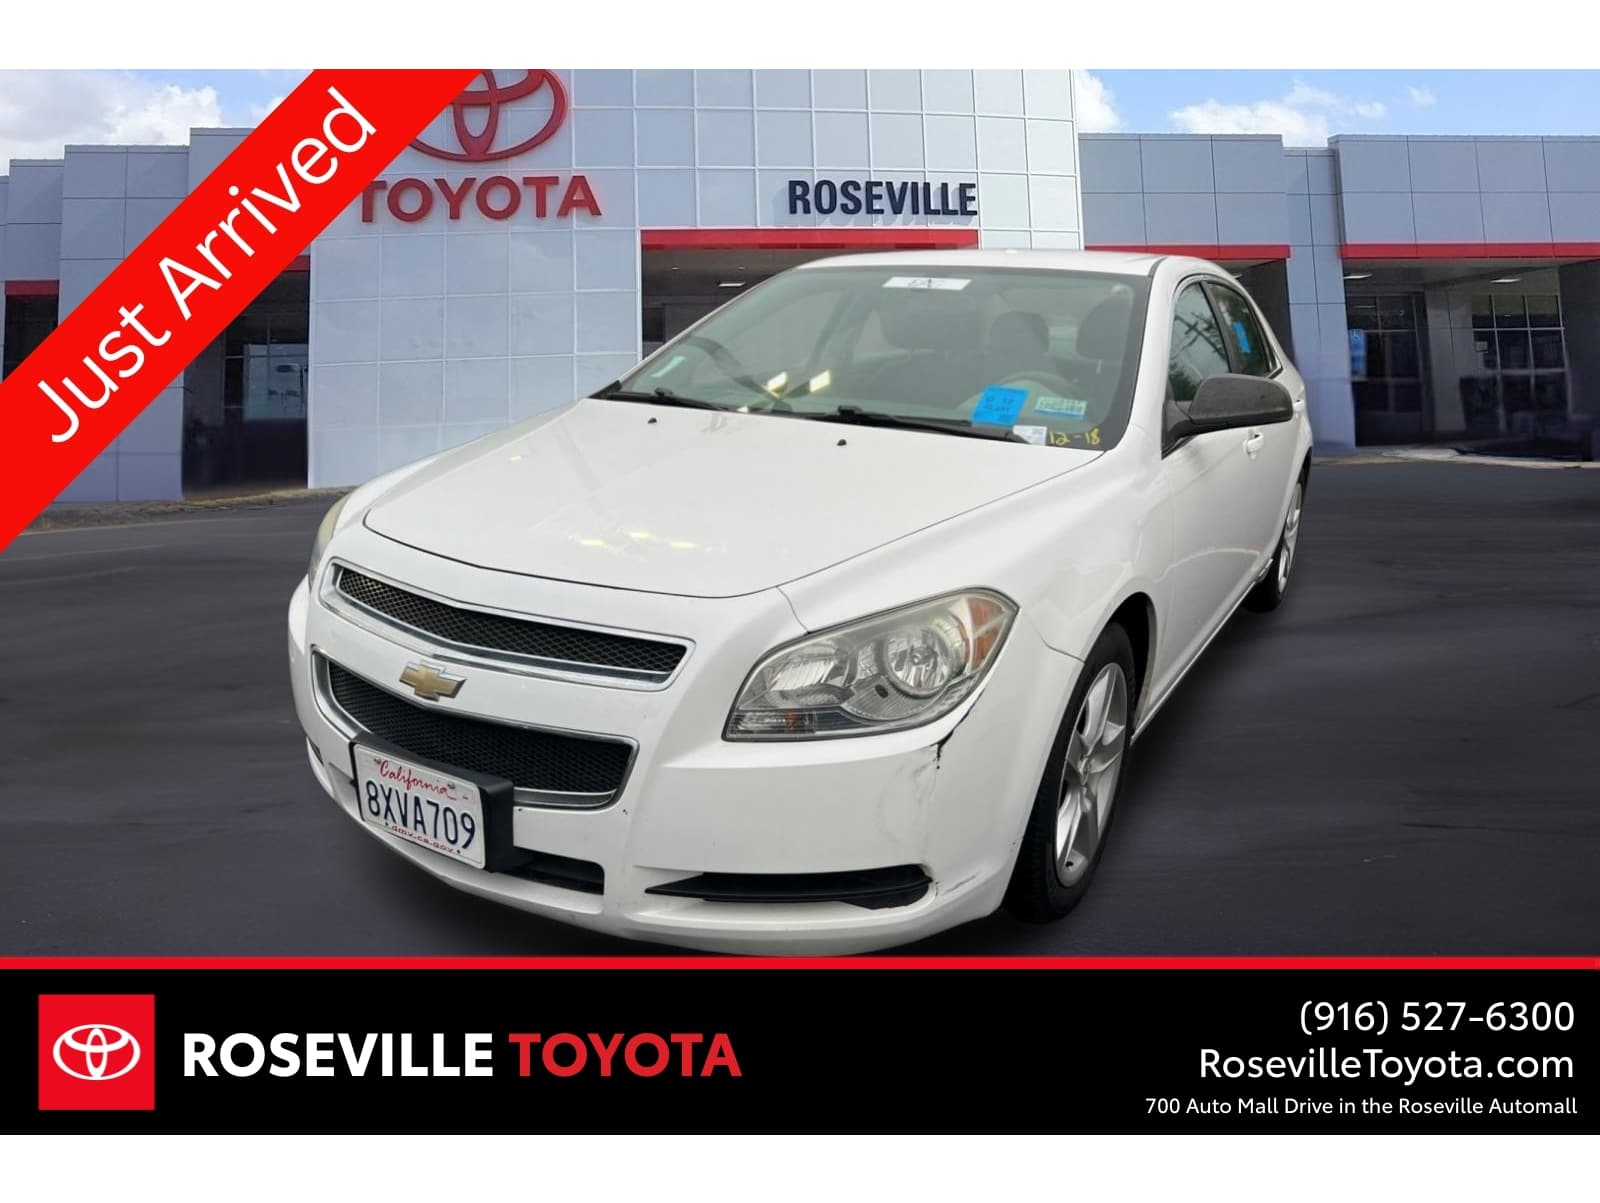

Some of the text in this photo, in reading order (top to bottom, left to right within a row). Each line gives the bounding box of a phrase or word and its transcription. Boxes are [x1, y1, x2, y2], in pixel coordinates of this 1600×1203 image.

[361, 175, 602, 223] TOYOTA
[788, 180, 979, 216] ROSEVILLE
[380, 760, 457, 800] California
[365, 780, 476, 850] 8XVA709
